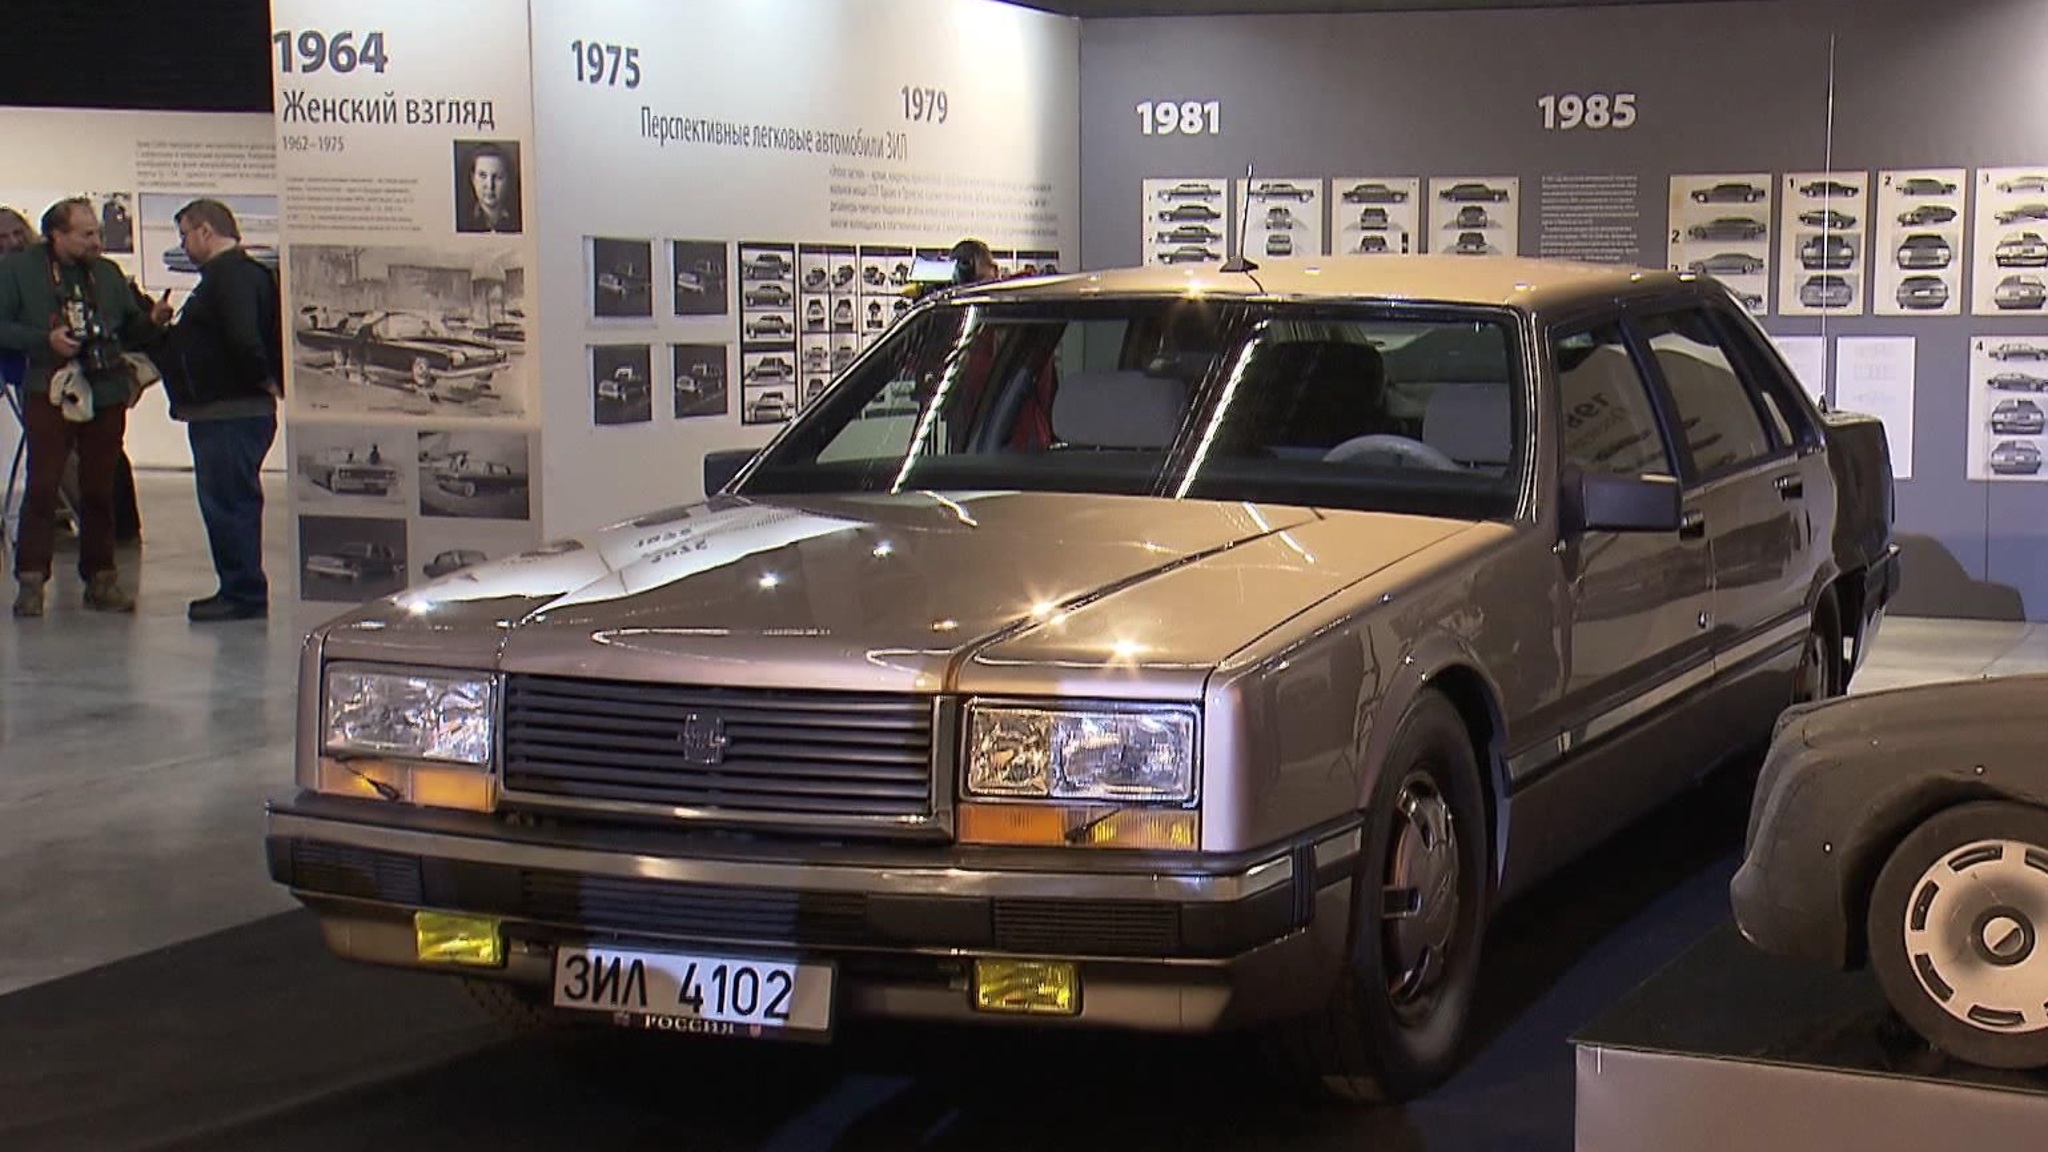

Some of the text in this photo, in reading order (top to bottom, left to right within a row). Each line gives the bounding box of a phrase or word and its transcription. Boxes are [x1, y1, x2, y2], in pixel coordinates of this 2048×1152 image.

[273, 30, 388, 74] 1964
[571, 39, 641, 89] 1975
[283, 90, 495, 130] Женский взгляд
[901, 86, 949, 124] 1979
[1136, 100, 1220, 135] 1981
[1538, 93, 1637, 130] 1985
[641, 106, 908, 160] Перспективные легковые автомобили ЗИЛ
[1672, 229, 1681, 244] 2
[563, 954, 793, 1022] ЗИЛ 4102
[644, 1013, 735, 1035] РОССИЯ
